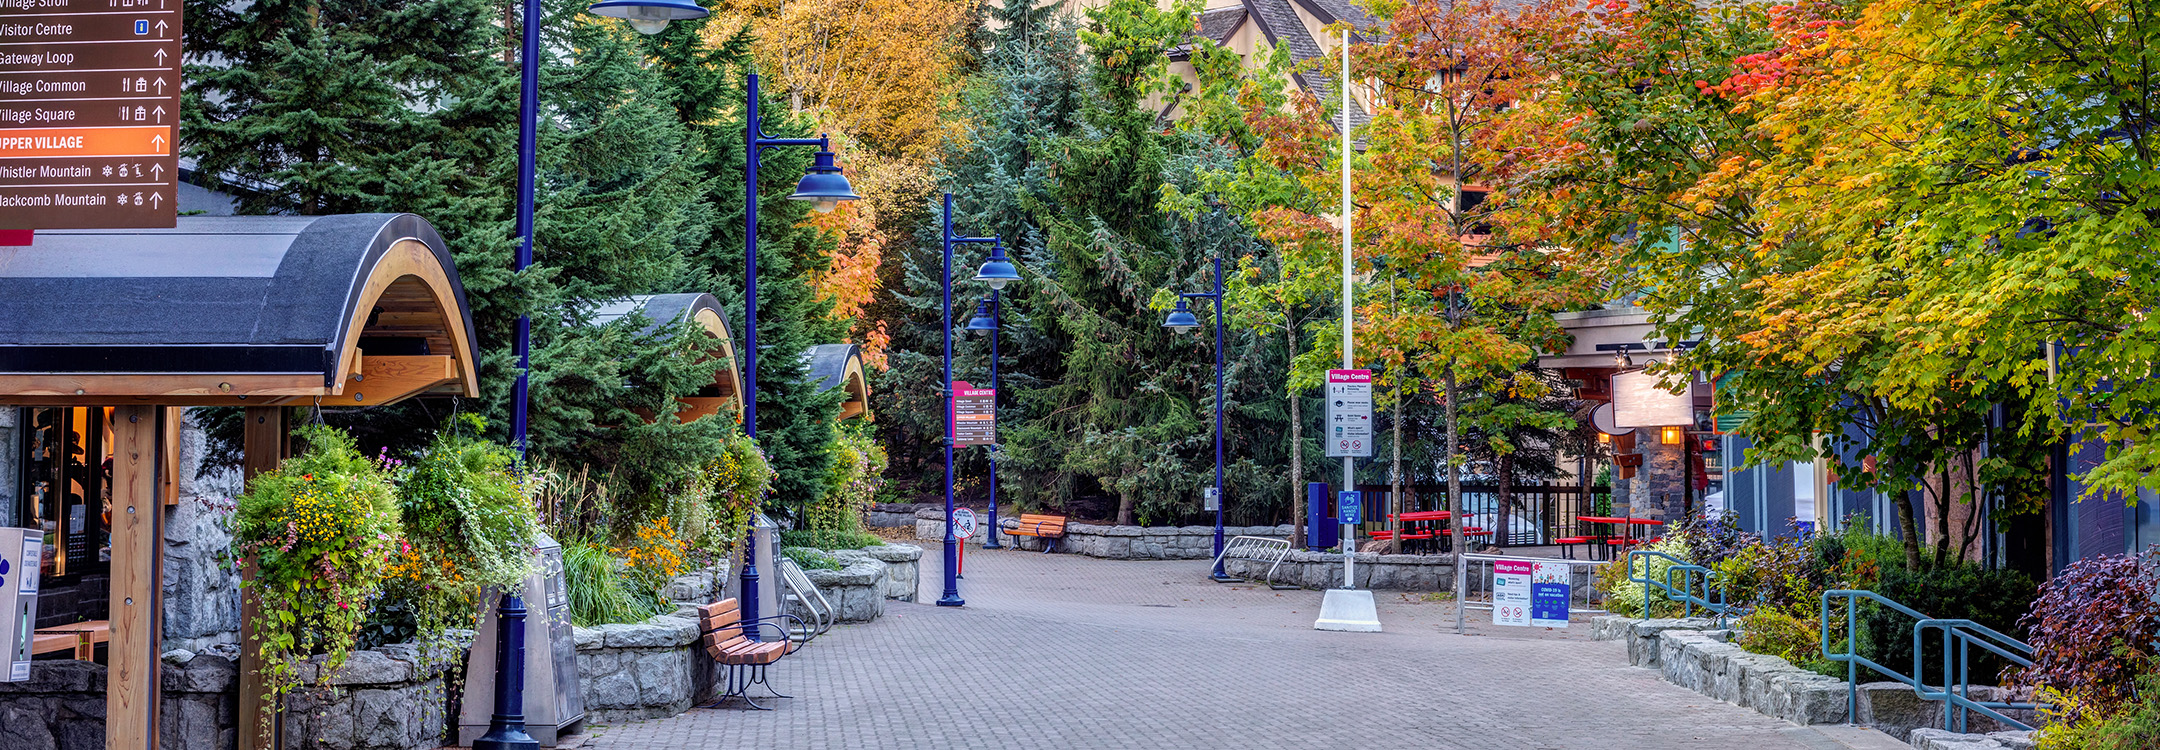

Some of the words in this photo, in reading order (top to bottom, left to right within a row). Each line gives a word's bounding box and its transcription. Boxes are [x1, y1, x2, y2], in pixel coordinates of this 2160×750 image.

[35, 23, 73, 35] Centre
[0, 52, 43, 66] Gateway
[46, 51, 74, 66] Loop
[36, 80, 86, 92] Common
[0, 109, 32, 124] illage
[35, 108, 75, 123] Square
[35, 136, 83, 149] VILLAGE
[0, 165, 36, 178] histler
[40, 165, 91, 177] Mountain
[0, 194, 51, 206] lackcomb
[55, 194, 106, 206] Mountain
[1496, 564, 1512, 572] Village
